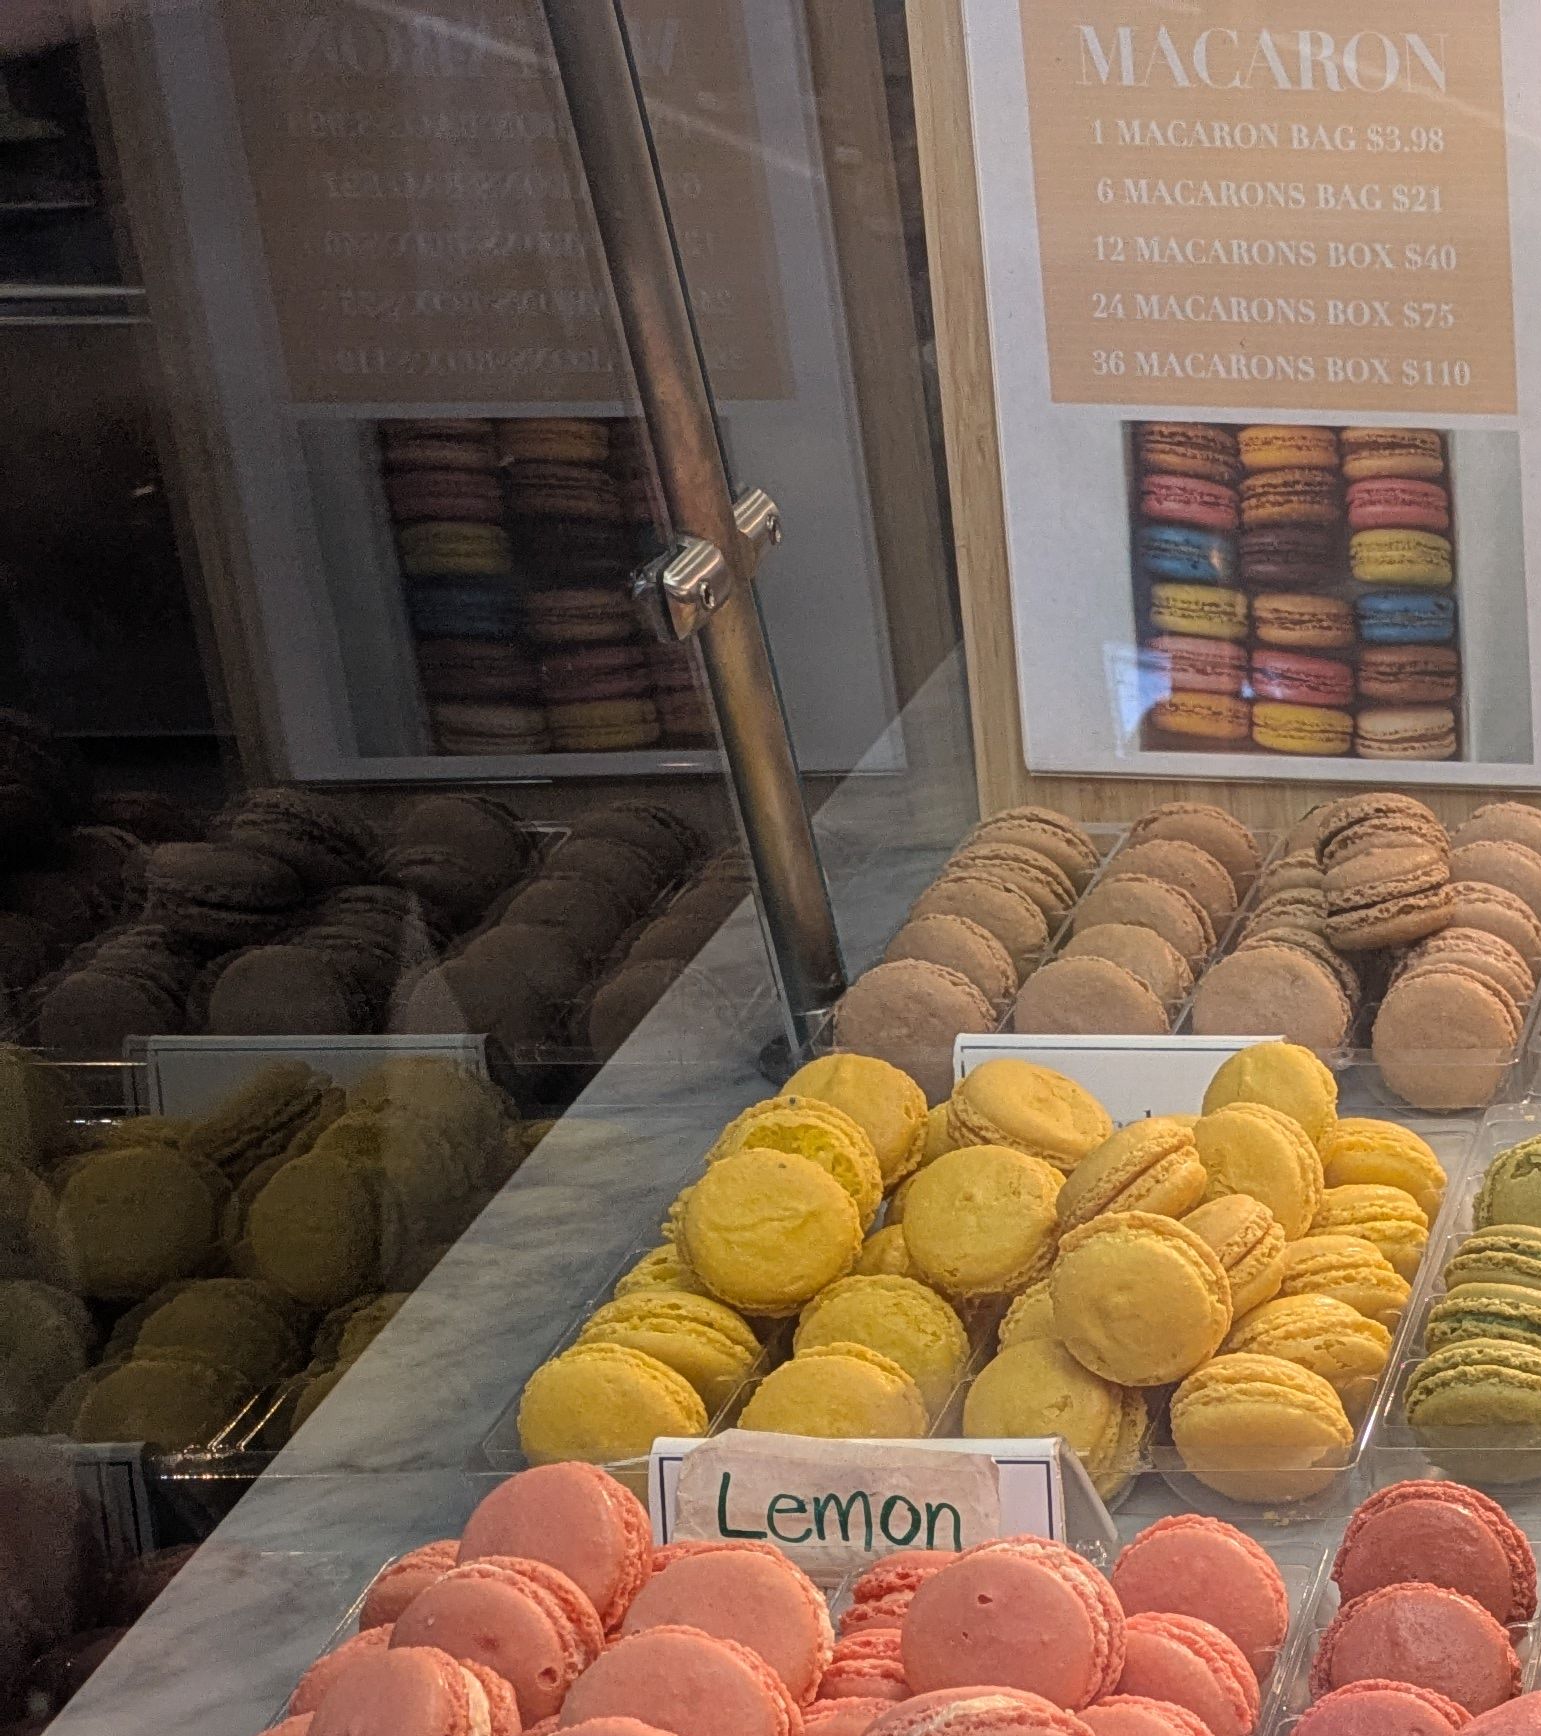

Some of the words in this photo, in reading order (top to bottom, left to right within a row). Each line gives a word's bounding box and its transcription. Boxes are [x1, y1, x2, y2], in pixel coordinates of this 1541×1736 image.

[1076, 24, 1449, 95] MACARON
[1091, 119, 1103, 145] 1
[1116, 119, 1279, 149] MACARON
[1291, 124, 1357, 151] BAG
[1366, 125, 1445, 153] $3.98
[1096, 176, 1114, 204] 6
[1123, 177, 1306, 209] MACARONS
[1316, 183, 1383, 211] BAG
[1392, 184, 1442, 213] $21
[1093, 235, 1126, 262] 12
[1134, 236, 1317, 267] MACARONS
[1327, 241, 1395, 269] BOX
[1404, 243, 1457, 271] $40
[1092, 293, 1126, 319] 24
[1134, 293, 1316, 325] MACARONS
[1326, 299, 1394, 327] BOX
[1403, 302, 1455, 329] $75
[1092, 349, 1126, 376] 36
[1134, 350, 1316, 382] MACARONS
[1325, 356, 1393, 384] BOX
[1401, 358, 1471, 387] $110
[718, 1471, 963, 1552] Lemon
